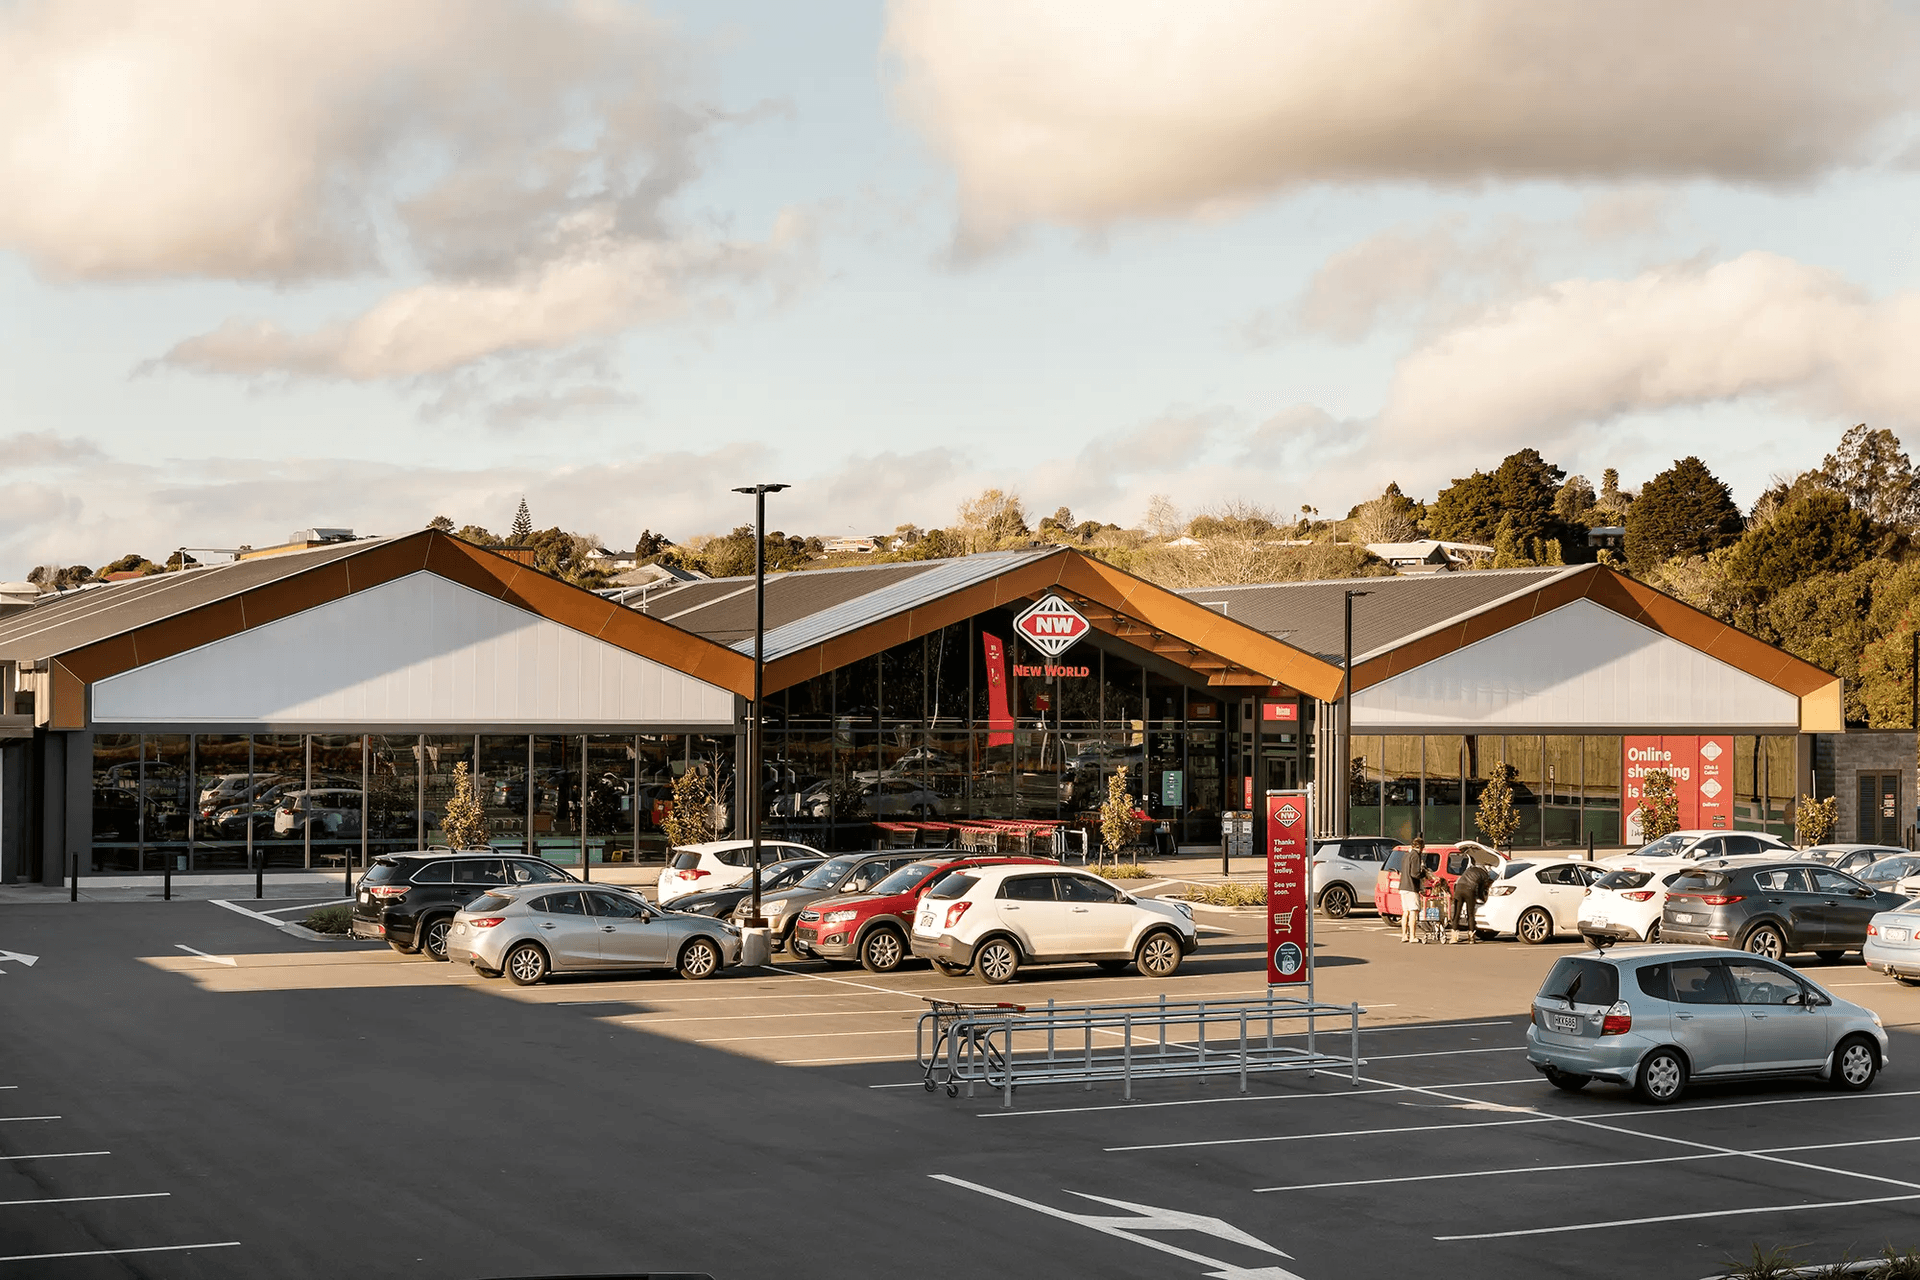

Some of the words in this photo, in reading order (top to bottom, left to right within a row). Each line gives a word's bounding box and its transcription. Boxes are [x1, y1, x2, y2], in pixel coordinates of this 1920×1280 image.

[1036, 616, 1074, 634] NW
[1627, 747, 1672, 761] Online
[1627, 783, 1639, 798] is
[1280, 811, 1295, 819] NW
[1273, 867, 1294, 875] trolley.
